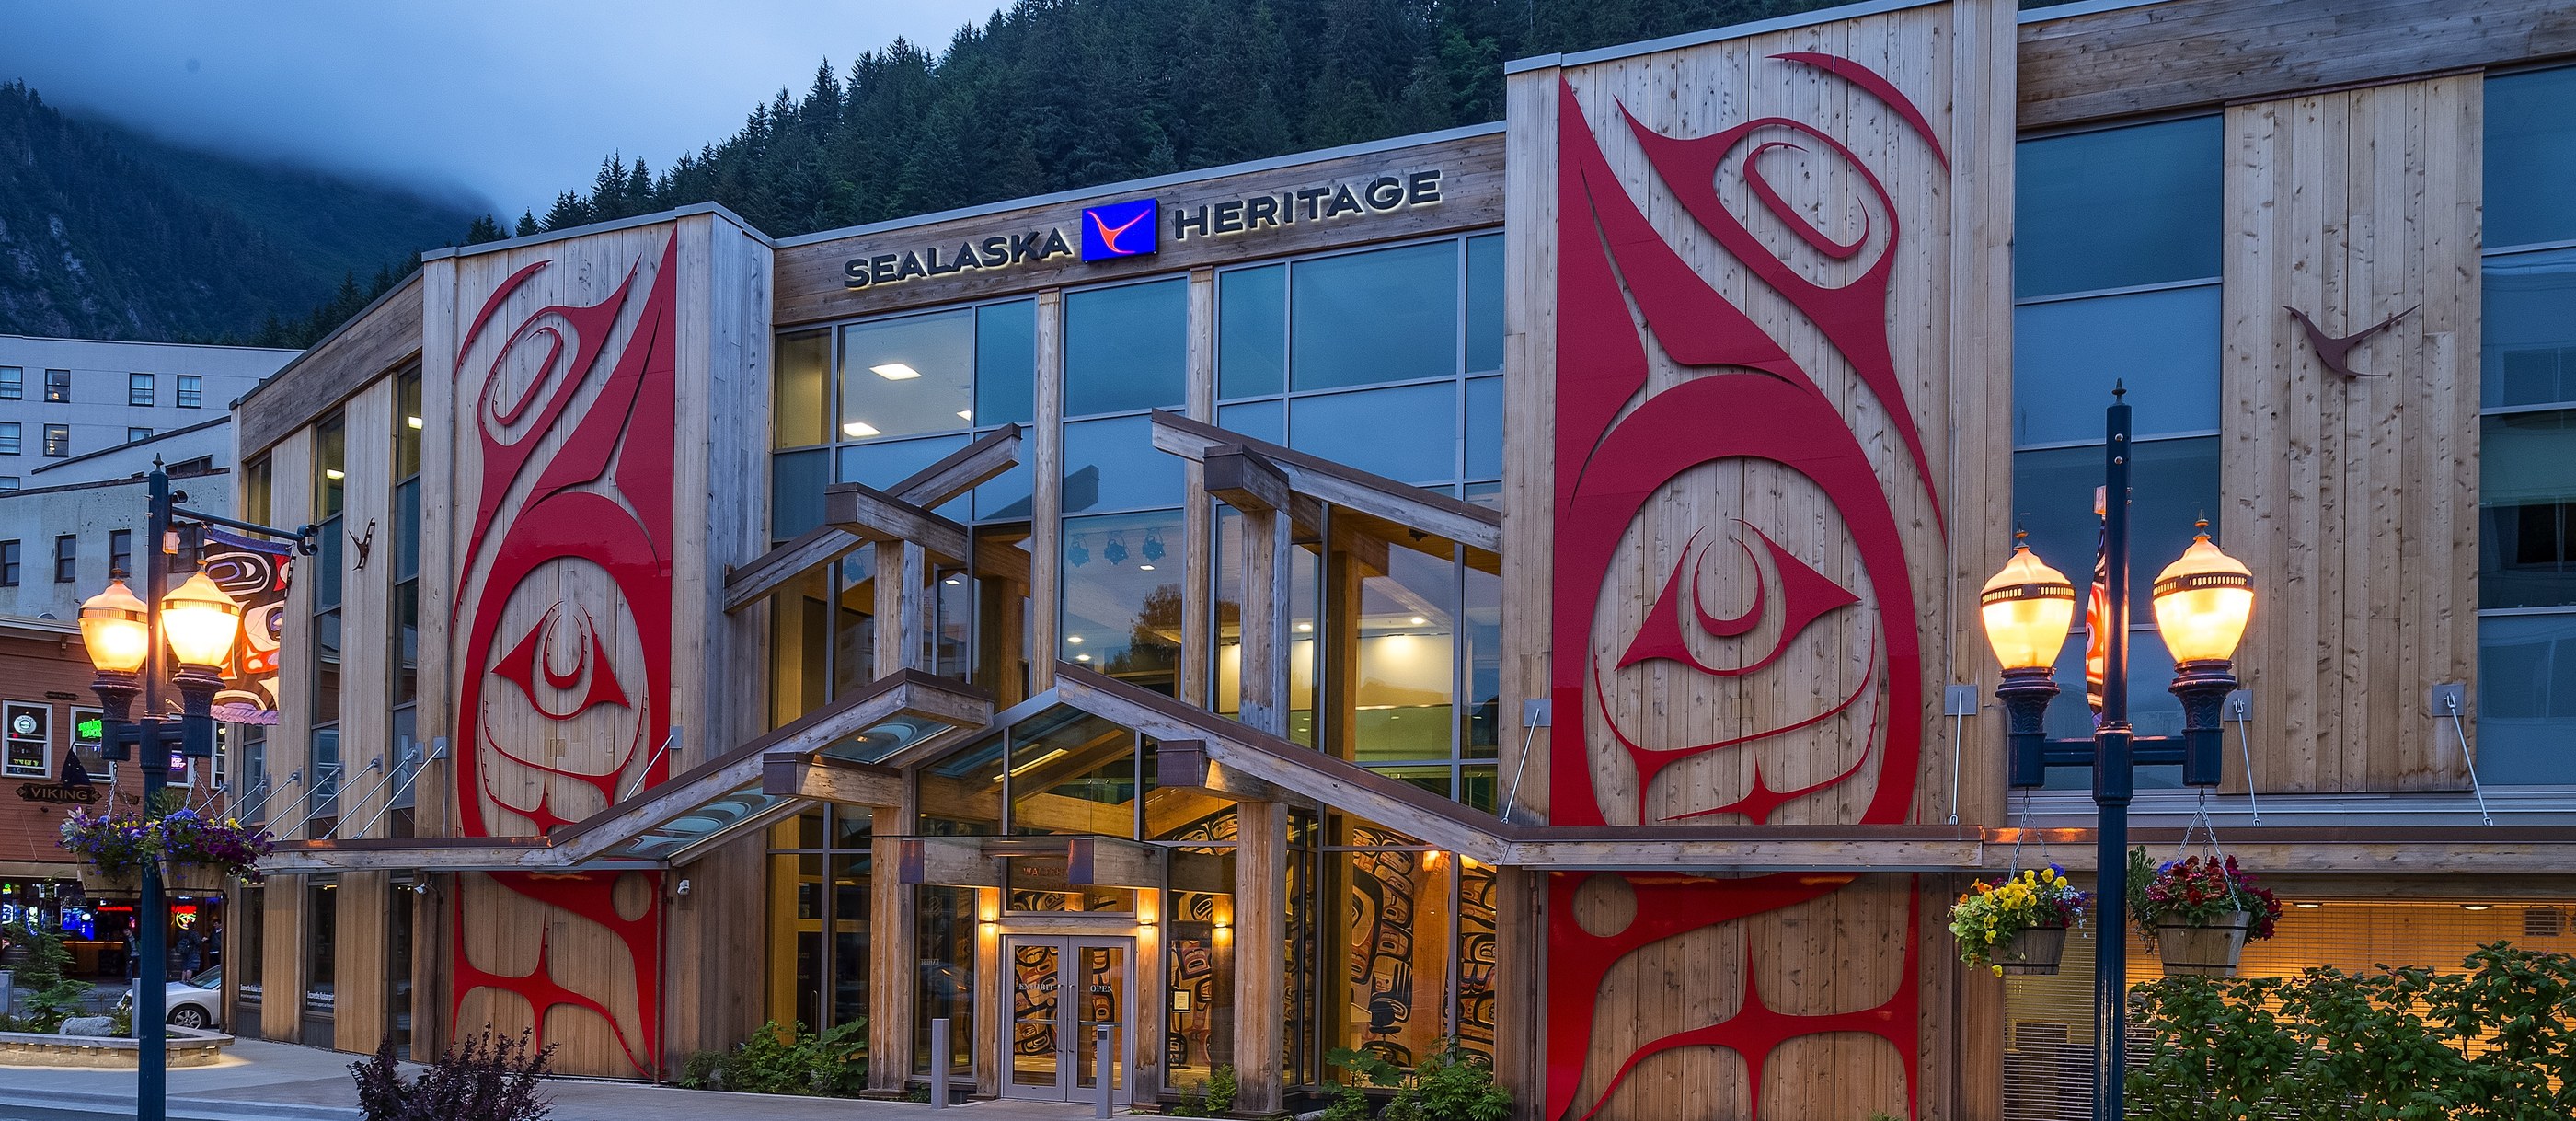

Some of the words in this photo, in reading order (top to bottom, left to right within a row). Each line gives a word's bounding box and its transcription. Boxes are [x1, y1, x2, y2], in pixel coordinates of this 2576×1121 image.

[844, 227, 1073, 287] SEALASKA
[1175, 169, 1442, 239] HERITAGE
[31, 787, 88, 801] VIKING
[1018, 983, 1053, 991] EXHIBIT
[1090, 984, 1113, 993] OPEN
